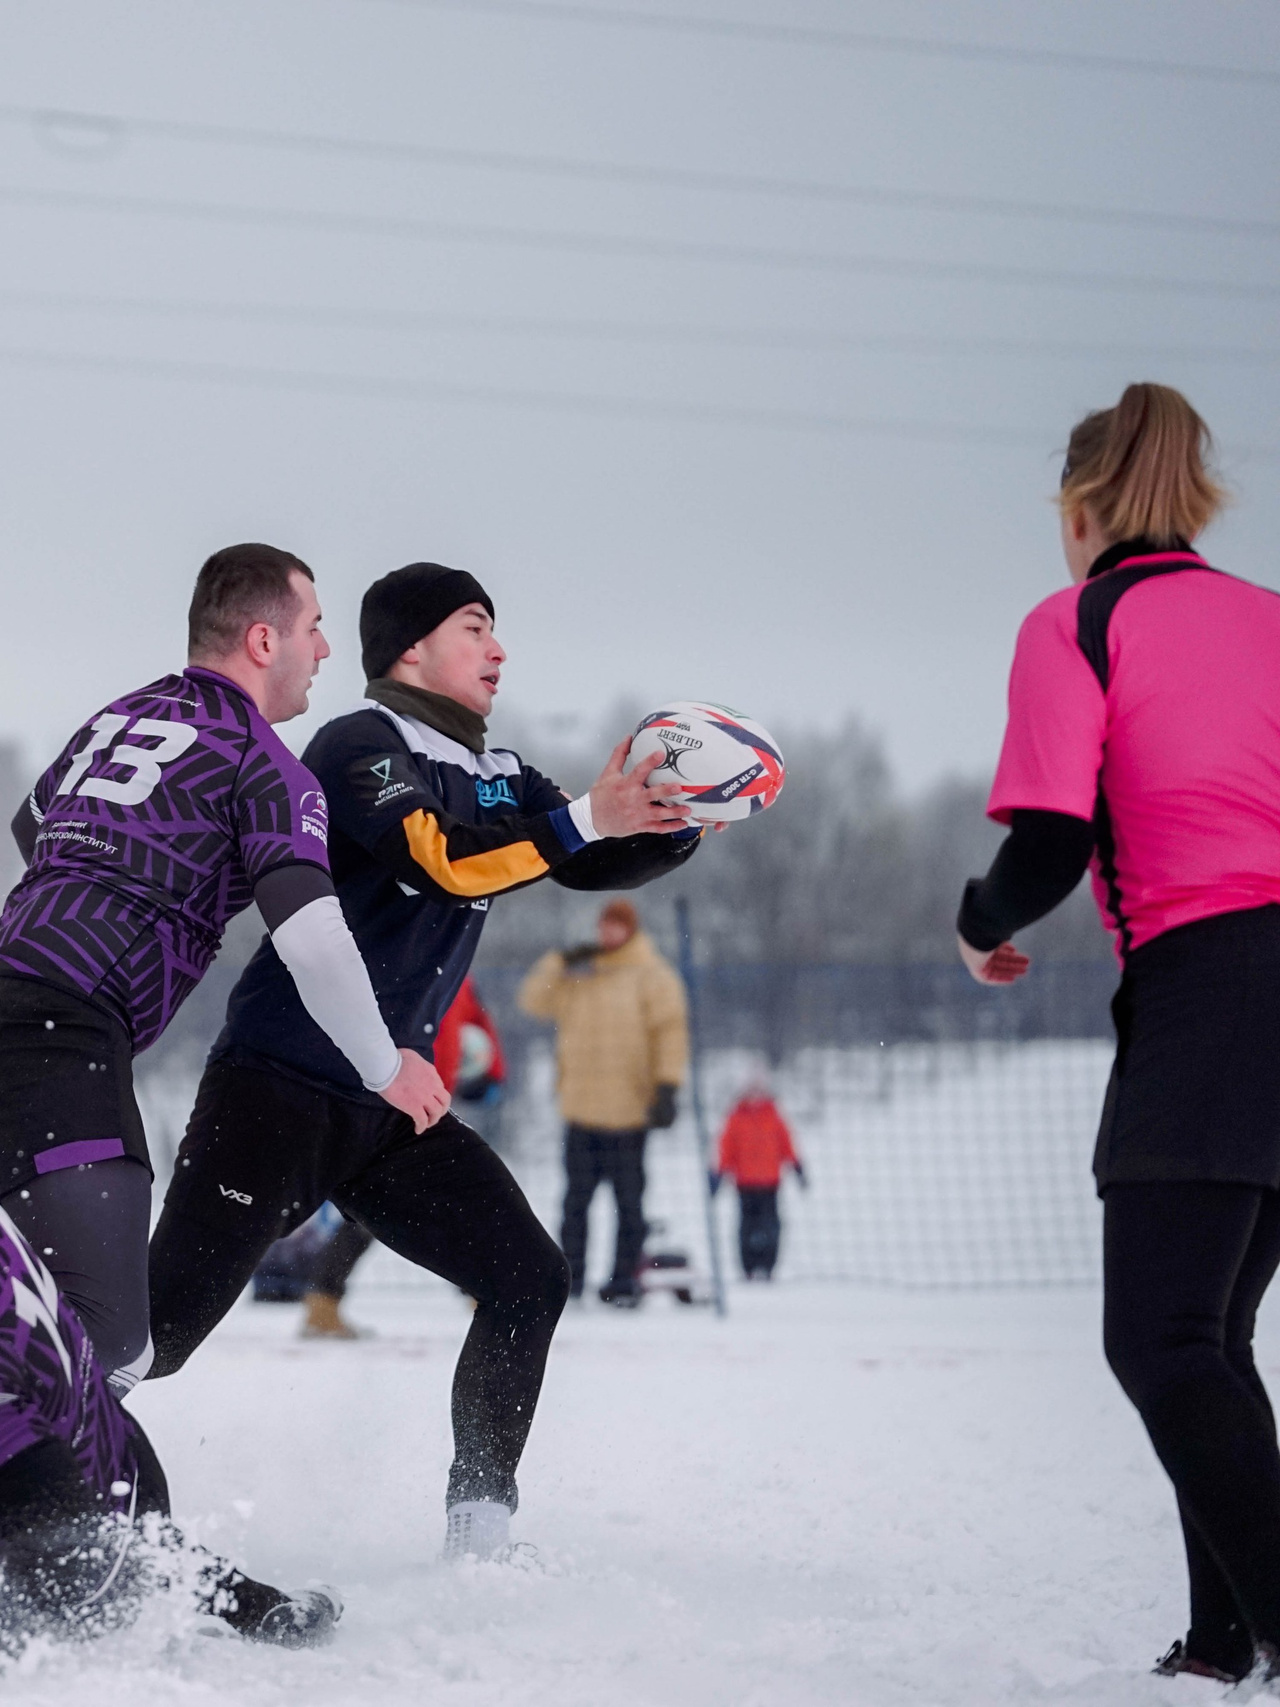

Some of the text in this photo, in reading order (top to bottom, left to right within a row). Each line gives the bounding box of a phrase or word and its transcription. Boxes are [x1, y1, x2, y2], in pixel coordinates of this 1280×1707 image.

[657, 728, 703, 749] GILBERT
[56, 713, 199, 806] 13
[378, 782, 405, 798] PARI
[721, 768, 758, 798] G-TR 3000
[72, 832, 118, 854] ИНСТИТУТ
[219, 1183, 253, 1205] VX3
